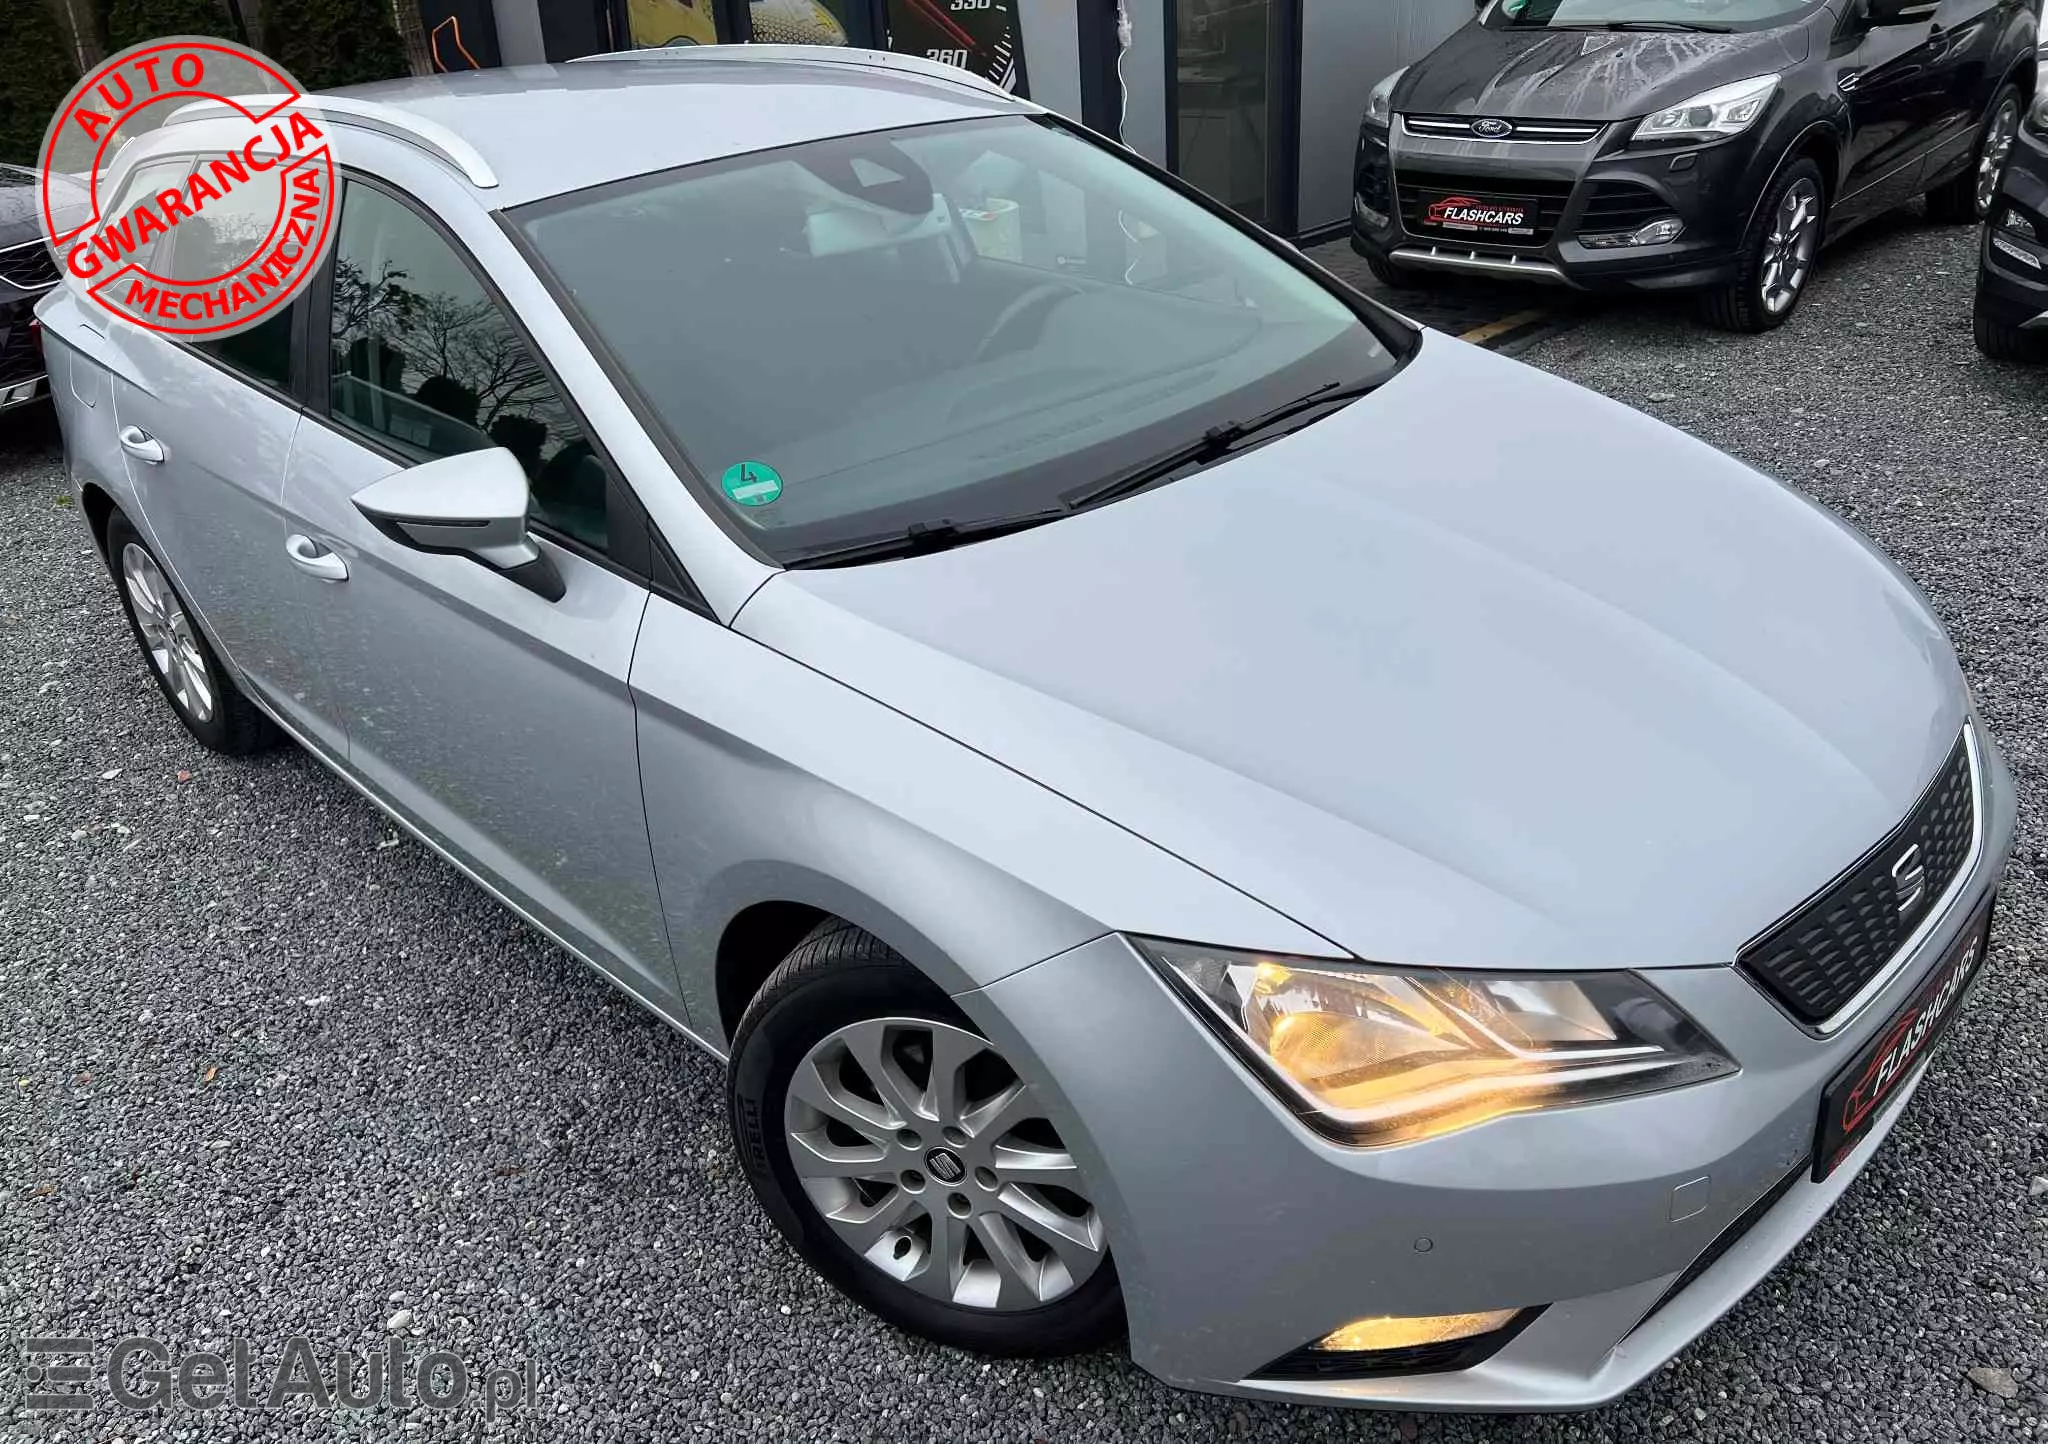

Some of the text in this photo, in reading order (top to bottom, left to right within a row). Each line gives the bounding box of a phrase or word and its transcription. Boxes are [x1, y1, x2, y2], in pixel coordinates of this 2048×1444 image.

[1443, 206, 1524, 225] FLASHCARS
[740, 463, 758, 483] 4
[1872, 936, 1978, 1097] FLASHCARS
